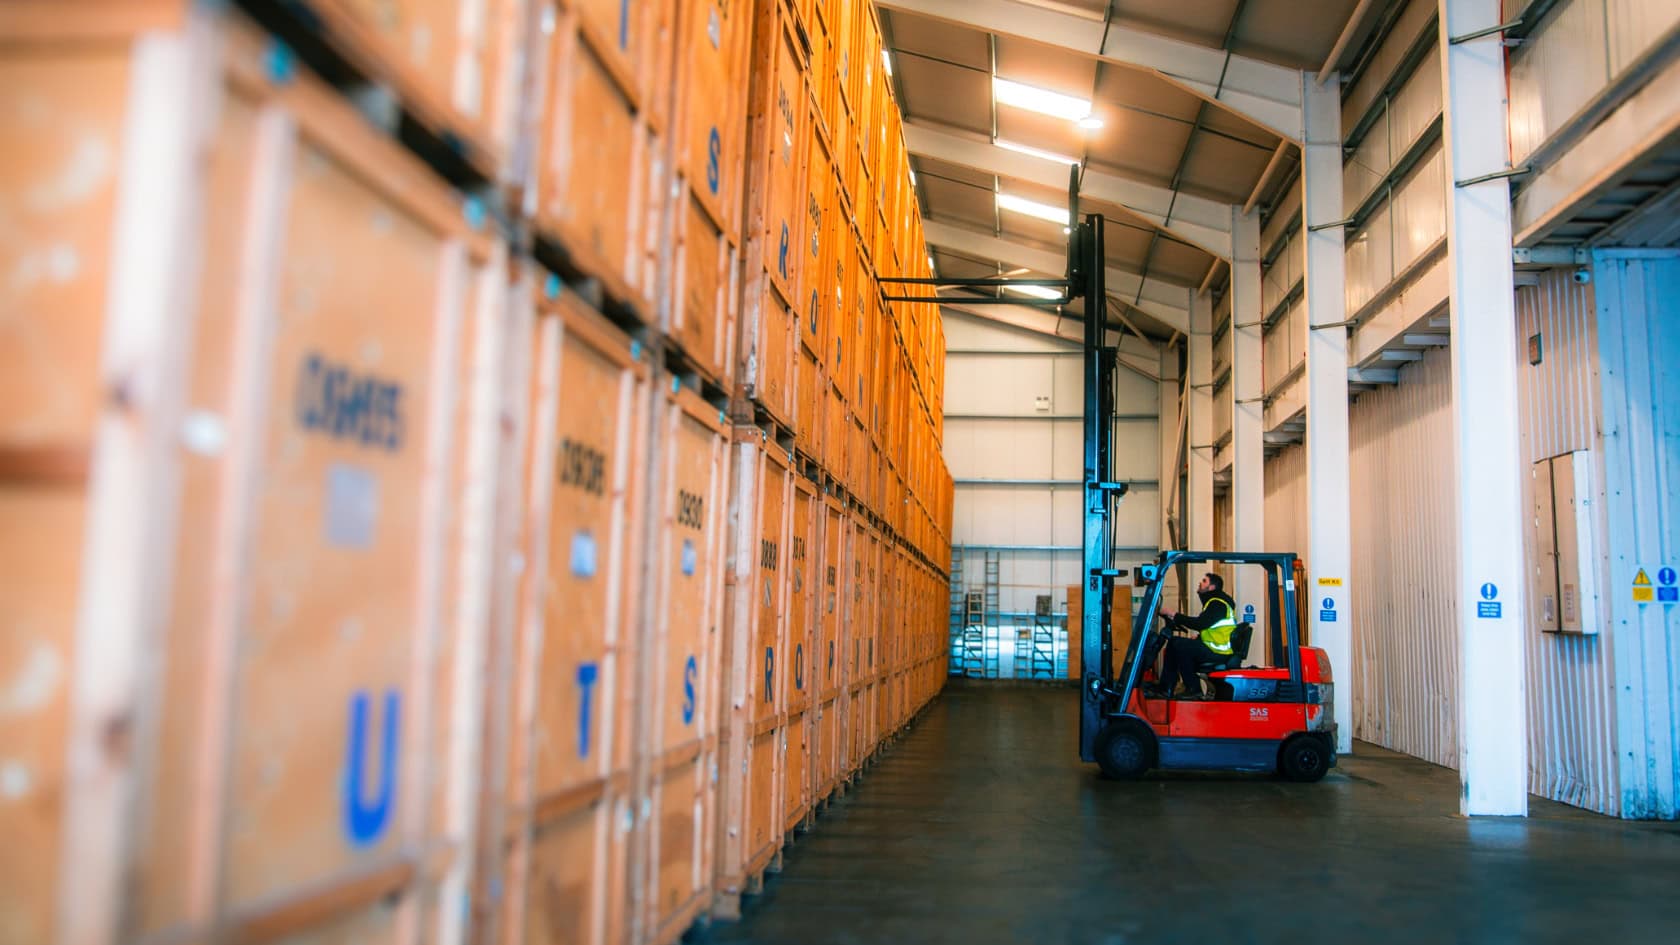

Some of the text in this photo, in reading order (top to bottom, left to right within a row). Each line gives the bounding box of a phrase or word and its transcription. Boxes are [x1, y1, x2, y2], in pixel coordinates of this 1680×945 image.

[707, 126, 720, 195] S
[779, 218, 788, 280] R
[683, 655, 697, 725] S
[765, 647, 774, 703] R
[576, 663, 598, 759] T
[1249, 707, 1269, 717] SAS
[343, 689, 401, 847] U
